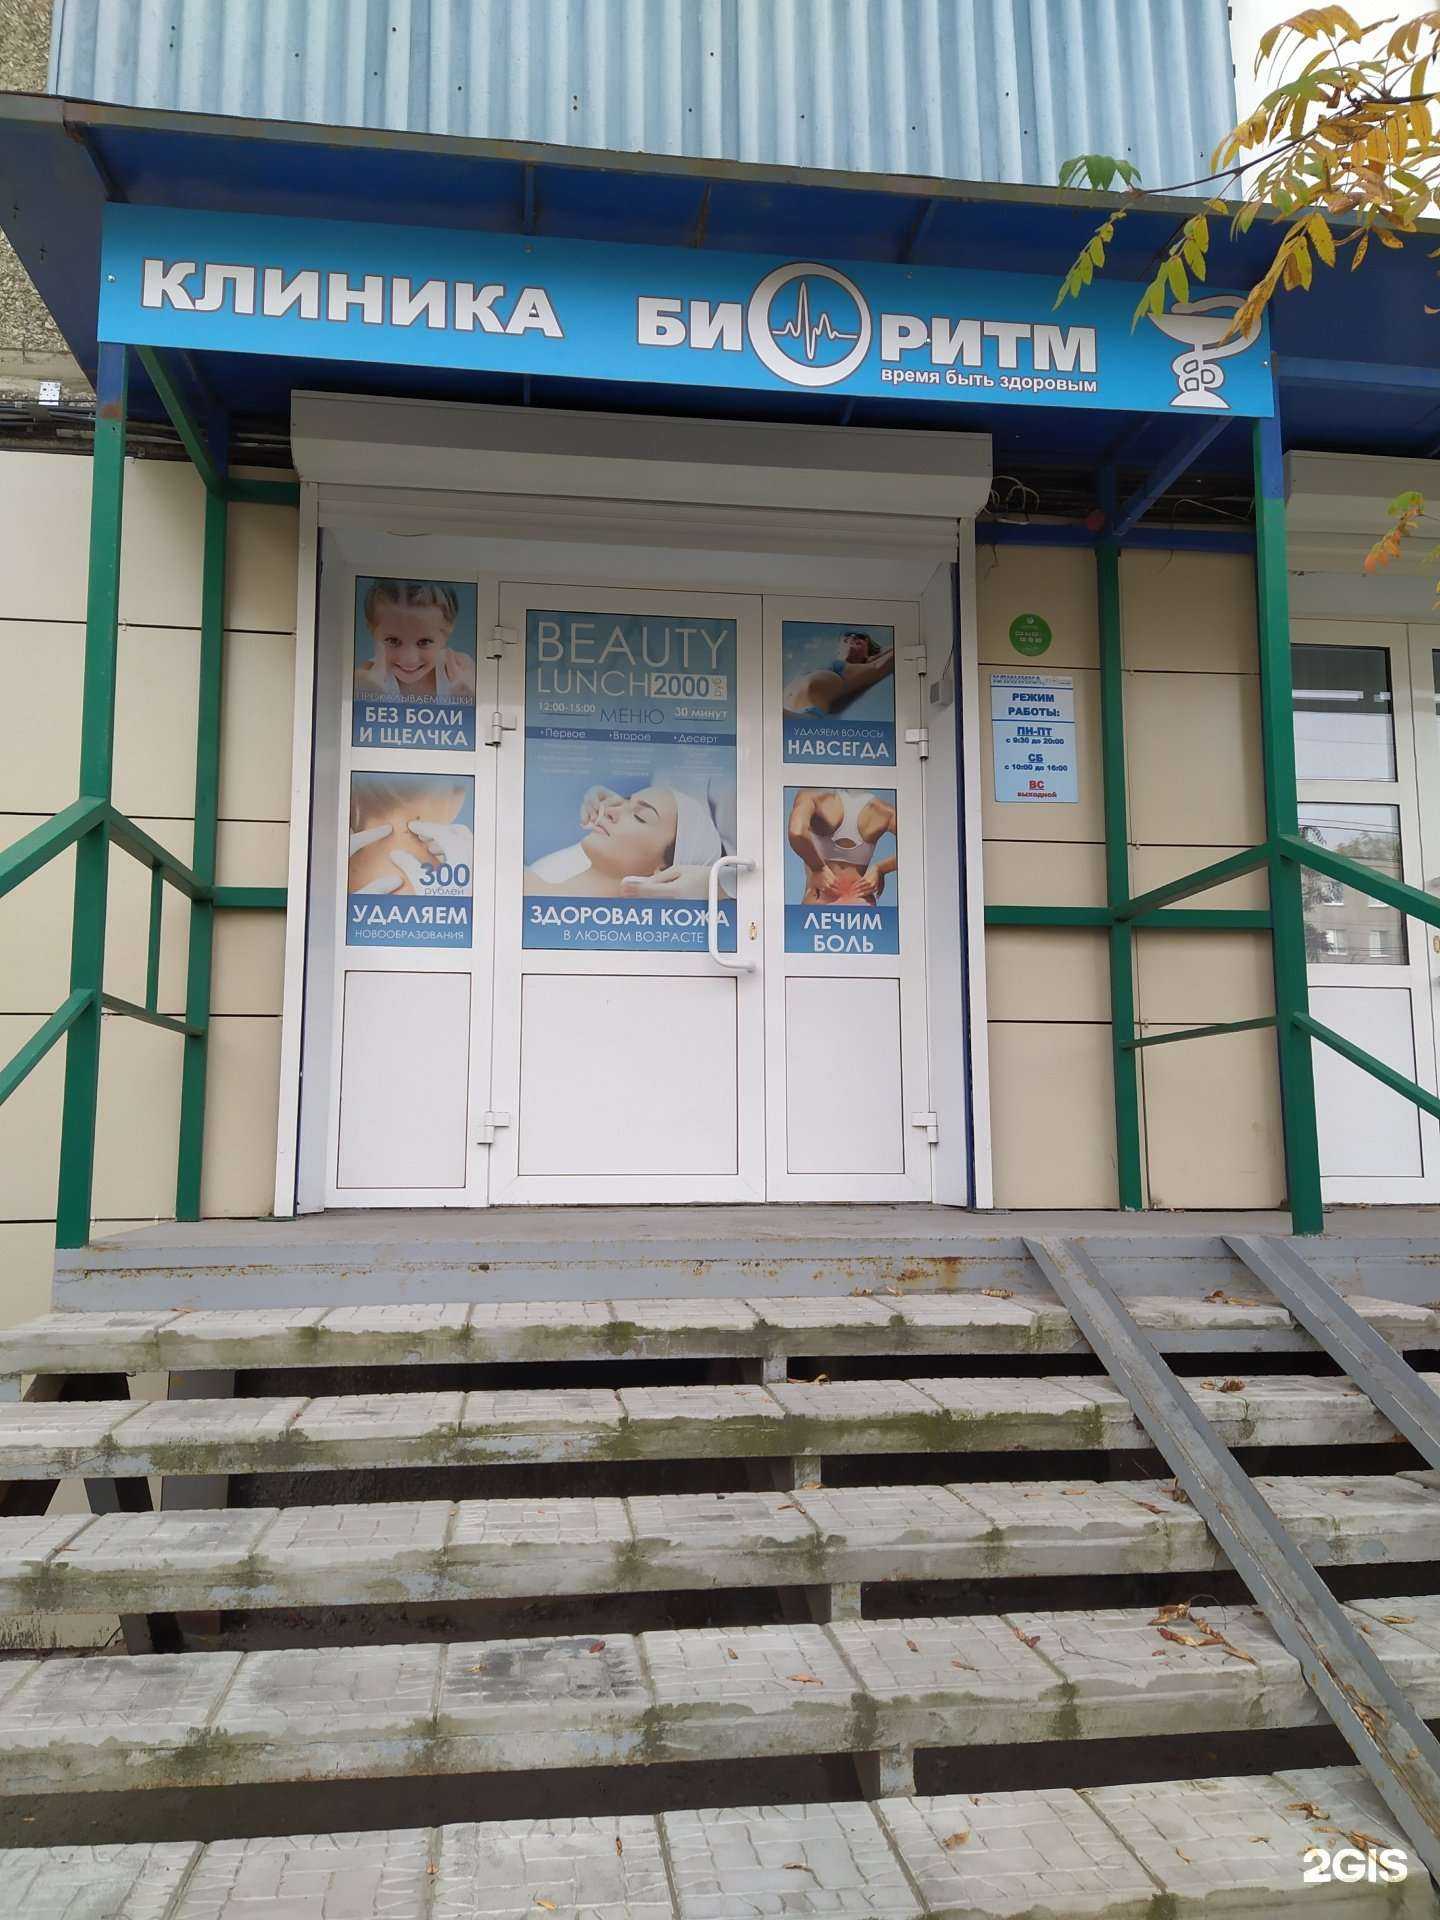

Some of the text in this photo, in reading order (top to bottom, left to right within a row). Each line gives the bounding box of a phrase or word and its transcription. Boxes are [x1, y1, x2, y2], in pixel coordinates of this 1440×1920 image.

[142, 258, 564, 338] КЛИНИКА
[881, 366, 1098, 393] время быть здоровым
[538, 621, 728, 669] BEAUTY
[538, 668, 648, 697] LUNCH
[653, 675, 710, 698] 2000
[1012, 692, 1055, 702] РЕЖИМ
[365, 706, 463, 726] БЕЗ БОЛИ
[600, 708, 665, 725] МЕНЮ
[674, 706, 728, 720] 30 минут
[1008, 706, 1060, 717] РАБОТЫ:
[360, 726, 468, 746] И ЩЕЛЧКА
[545, 729, 586, 740] Первое
[613, 731, 651, 741] Второе
[677, 733, 718, 745] Десерт
[794, 727, 884, 738] УДАЛЯЕМ ВОЛОСЫ
[1017, 727, 1053, 737] ПН-ПТ
[788, 739, 889, 759] НАВСЕГДА
[1028, 753, 1044, 763] СБ
[1029, 780, 1045, 790] ВС
[1017, 791, 1057, 799] выходной
[419, 863, 470, 887] 300
[352, 904, 468, 925] УДАЛЯЕМ
[530, 905, 730, 927] ЗДОРОВАЯ КОЖА
[804, 912, 882, 930] ЛЕЧИМ
[355, 928, 464, 940] НОВООБРАЗОВАНИЯ
[563, 930, 705, 943] В ЛЮБОМ ВОЗРАСТЕ
[814, 934, 874, 952] БОЛЬ
